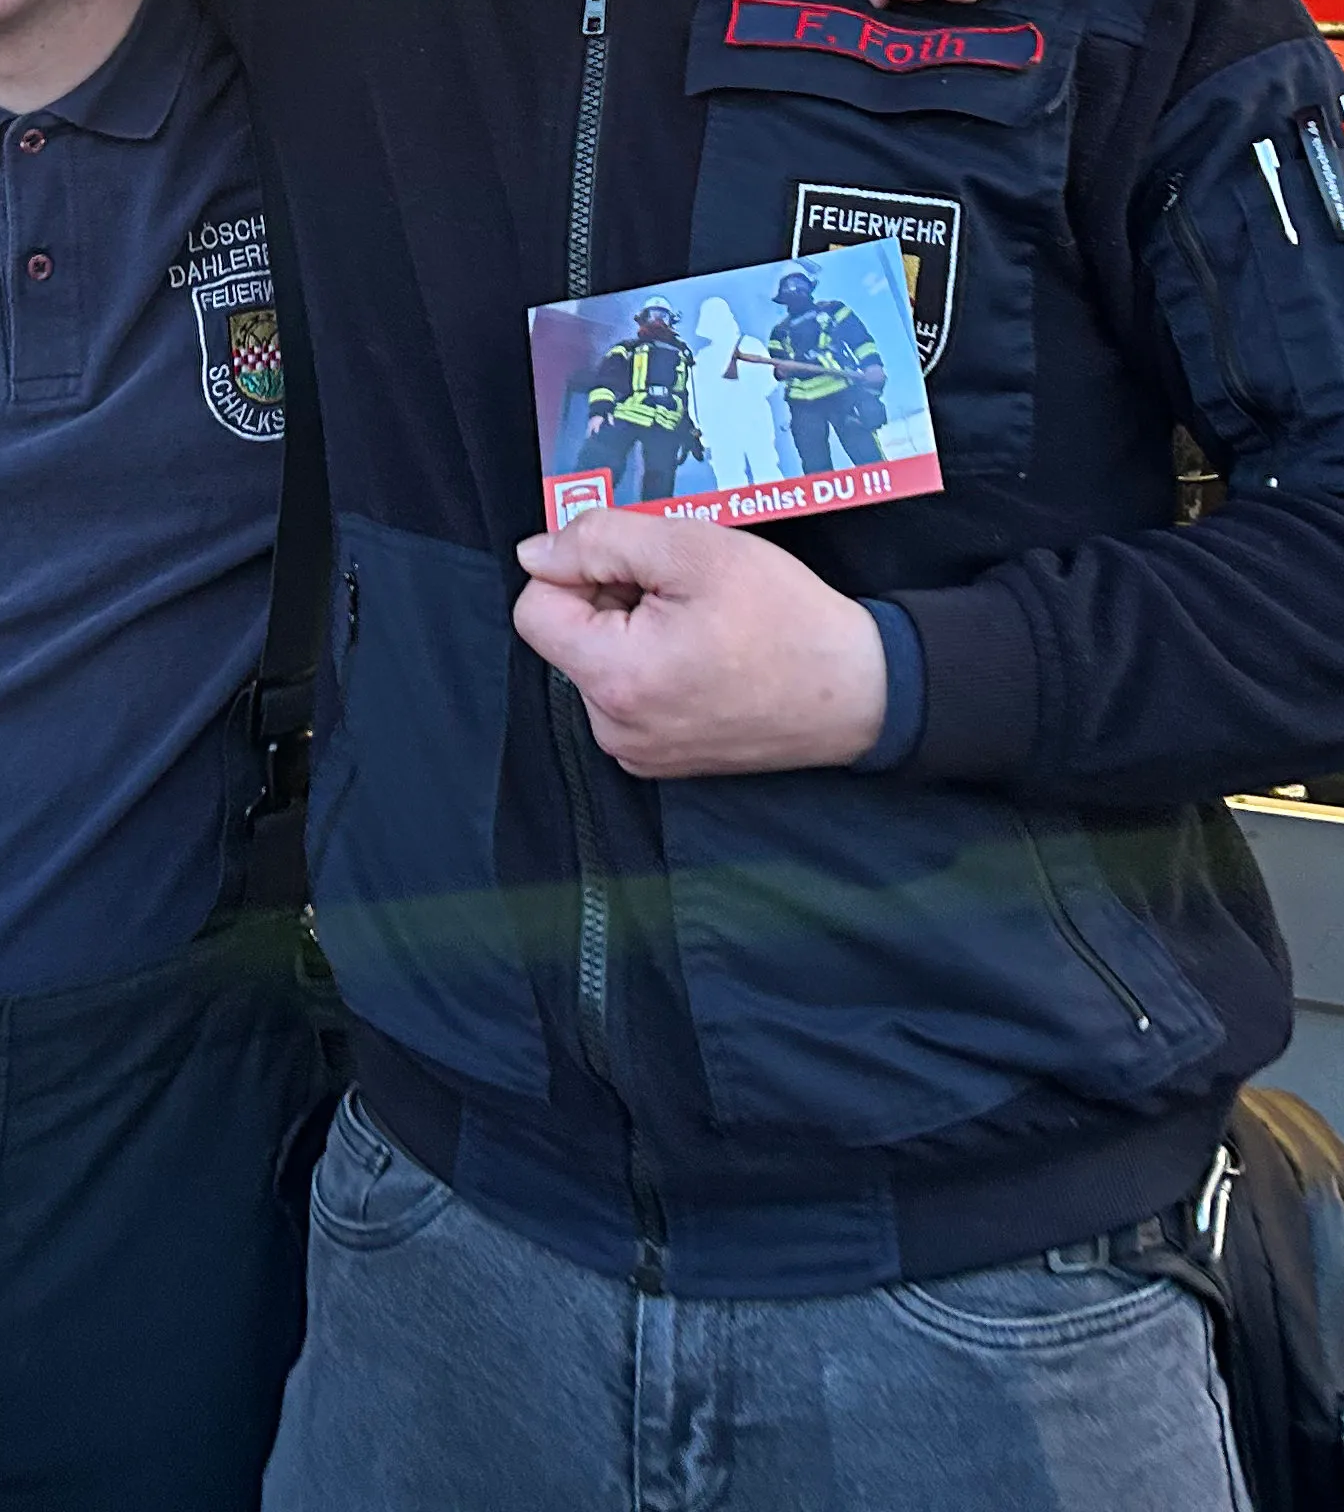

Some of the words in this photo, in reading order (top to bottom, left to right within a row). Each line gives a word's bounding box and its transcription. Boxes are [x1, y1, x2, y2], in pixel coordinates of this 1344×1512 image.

[795, 9, 838, 44] F.
[188, 214, 267, 253] LÖSCH
[809, 205, 948, 247] FEUERWEHR
[728, 486, 806, 518] fehlst
[812, 475, 854, 504] DU
